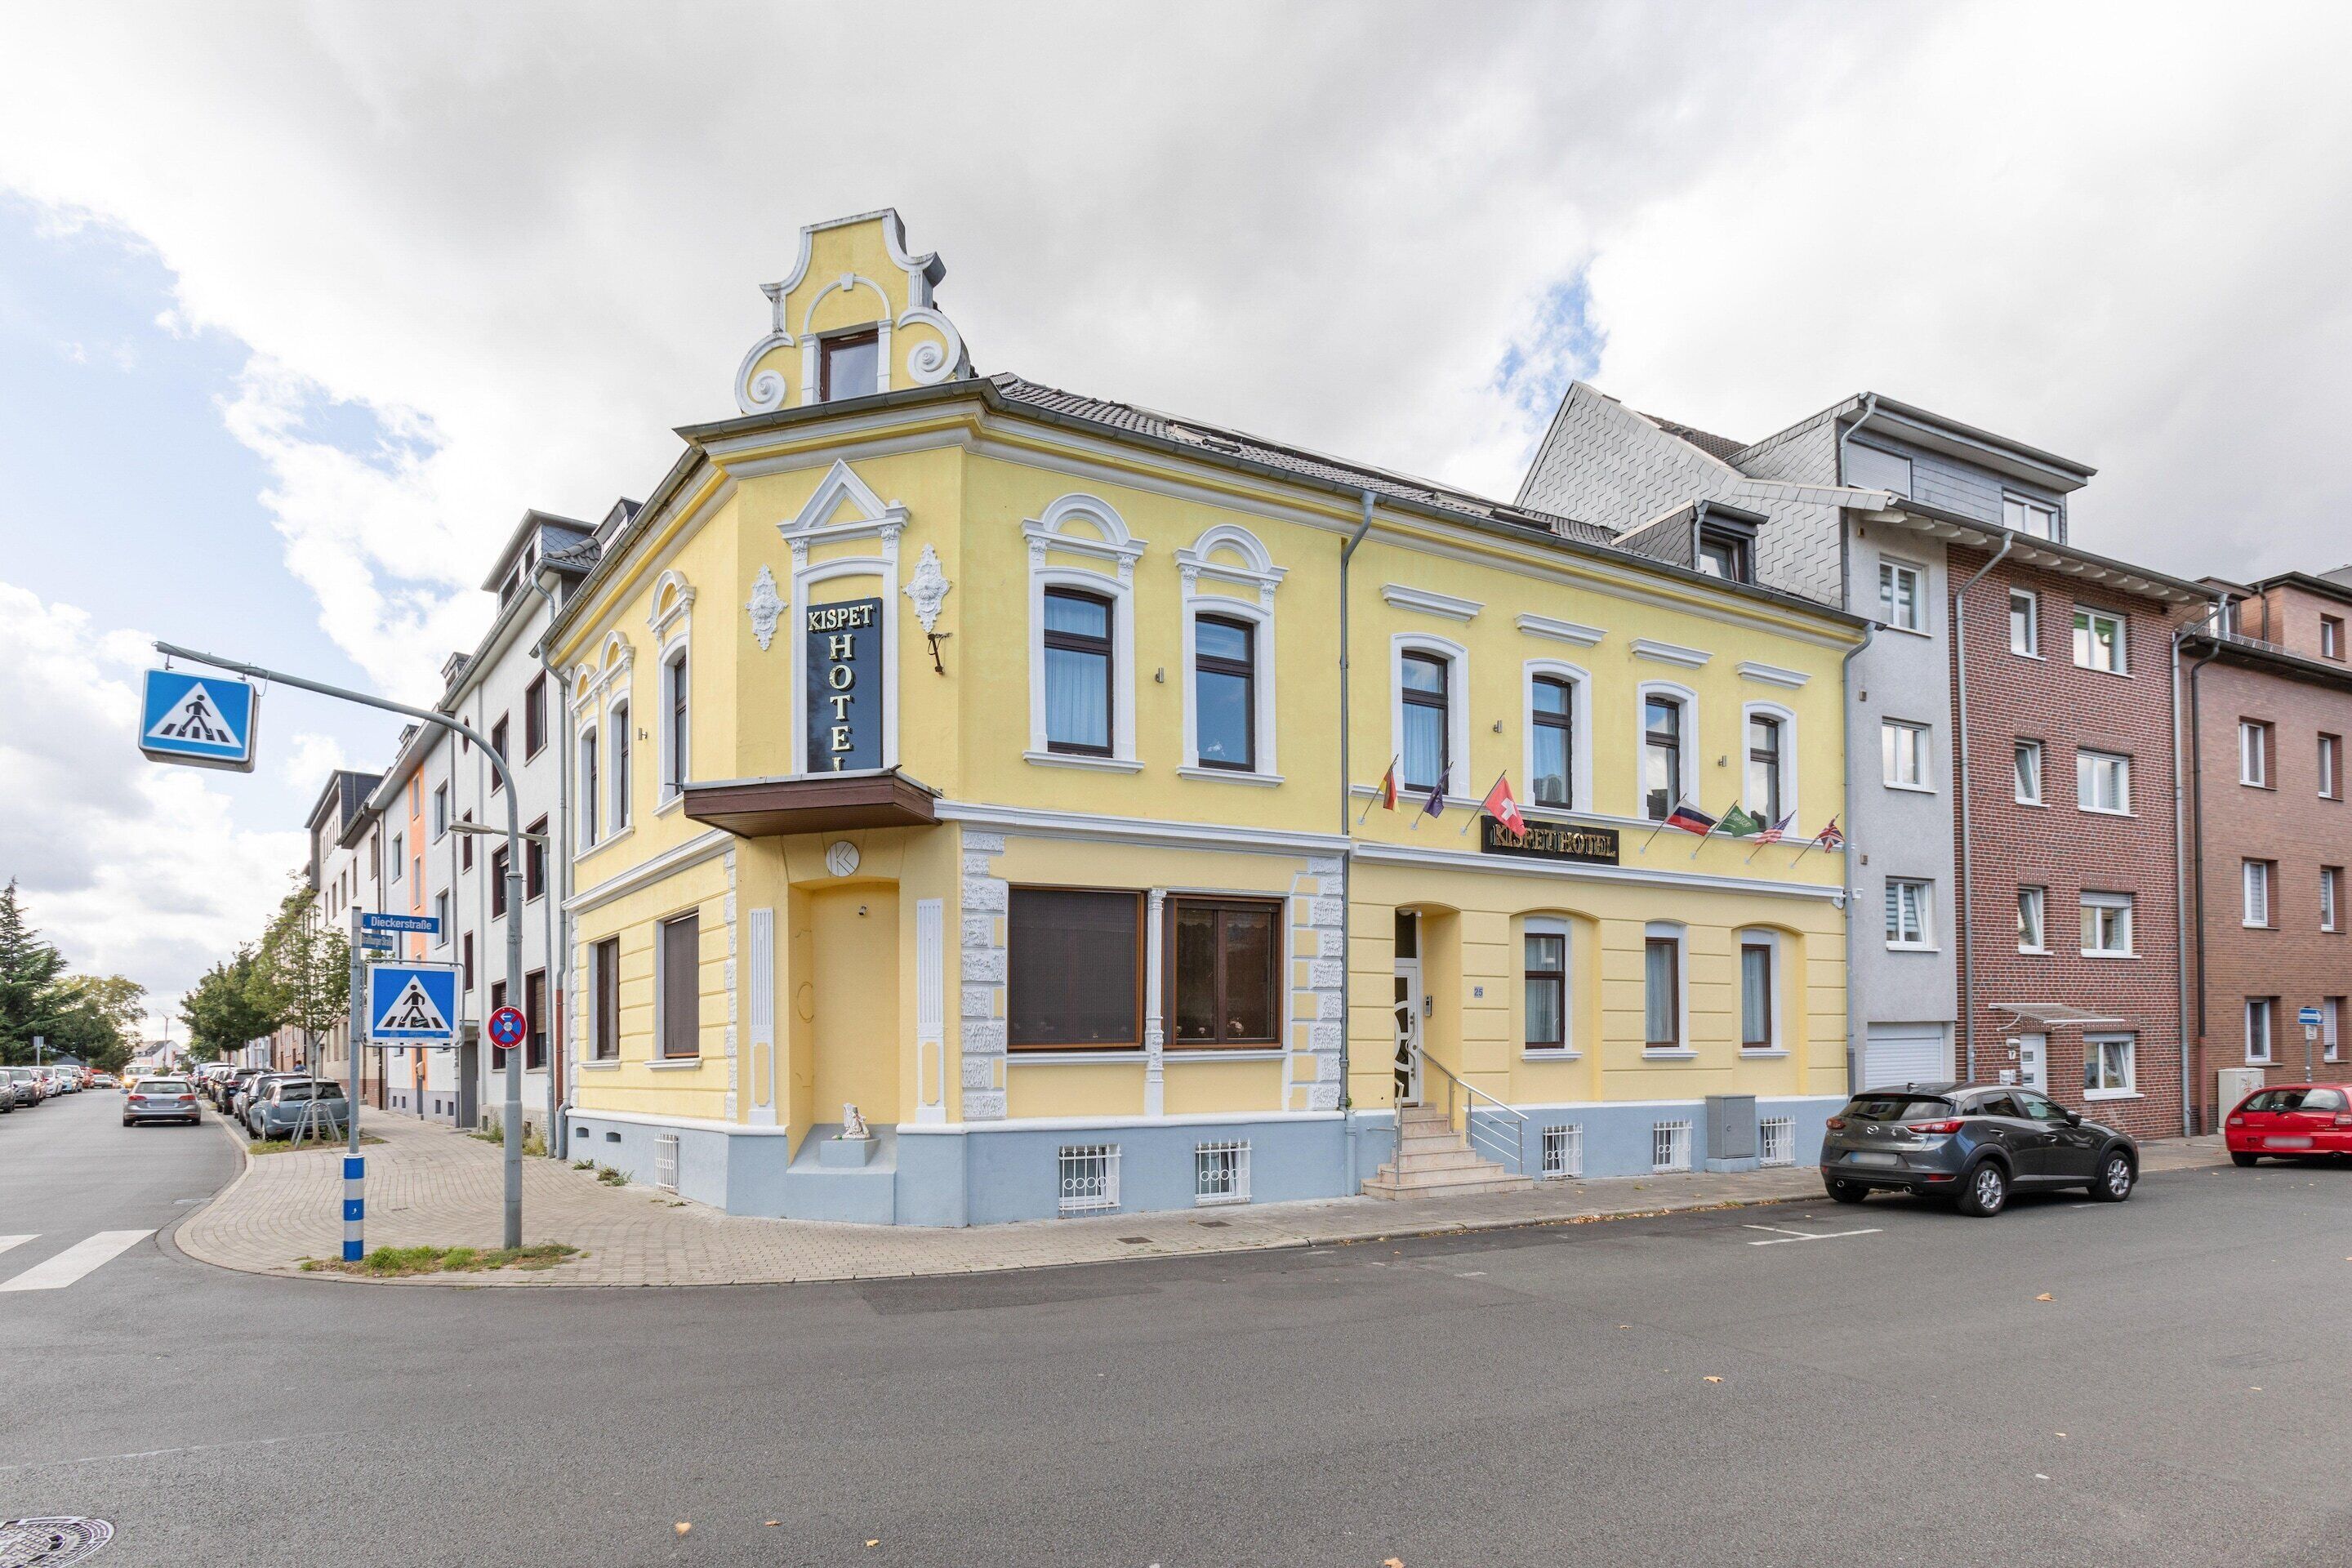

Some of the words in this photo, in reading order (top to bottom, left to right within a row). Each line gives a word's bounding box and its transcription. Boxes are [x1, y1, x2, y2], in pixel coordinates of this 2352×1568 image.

[808, 604, 874, 632] KISPET
[1557, 831, 1616, 858] HOTEL
[370, 915, 432, 930] Dieckerstraße
[1474, 988, 1483, 996] 25
[2007, 1050, 2016, 1060] 17
